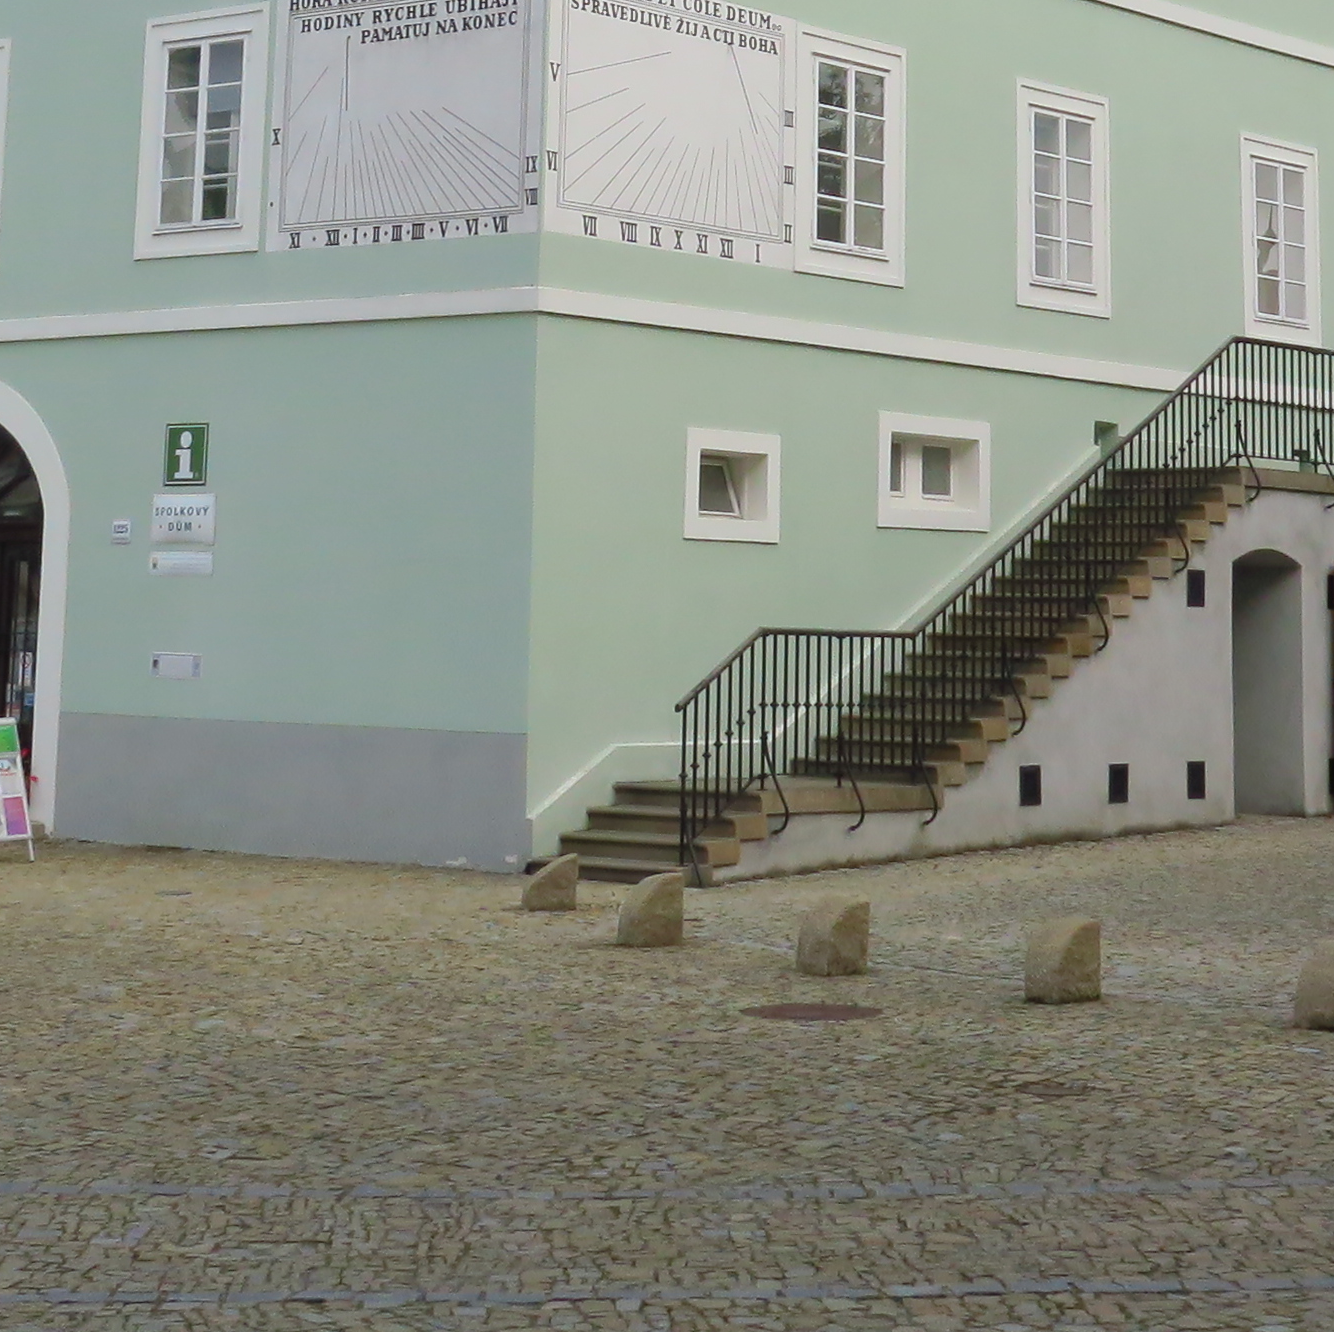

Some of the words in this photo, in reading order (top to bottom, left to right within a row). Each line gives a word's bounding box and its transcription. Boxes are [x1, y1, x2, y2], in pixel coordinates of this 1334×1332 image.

[300, 11, 365, 33] HODINY
[371, 2, 438, 25] RYCHLE
[360, 22, 430, 44] PAMATUJ
[435, 18, 458, 35] NA
[461, 10, 518, 32] KONEC
[699, 25, 712, 40] A
[739, 33, 779, 55] BOHA
[549, 61, 561, 82] V
[271, 128, 281, 146] X
[525, 155, 539, 173] IX
[546, 150, 558, 171] VI
[783, 165, 794, 185] III
[289, 232, 301, 249] XI
[325, 229, 341, 247] XII
[352, 227, 358, 245] I
[372, 226, 381, 243] II
[391, 224, 403, 242] III
[411, 223, 426, 240] IIII
[438, 220, 450, 238] V
[465, 218, 480, 236] VI
[492, 216, 509, 233] VII
[582, 214, 598, 237] VII
[620, 221, 638, 243] VIII
[649, 225, 662, 247] IX
[673, 229, 683, 250] X
[696, 233, 708, 254] XI
[719, 238, 734, 259] XII
[755, 244, 761, 263] I
[783, 223, 793, 244] II
